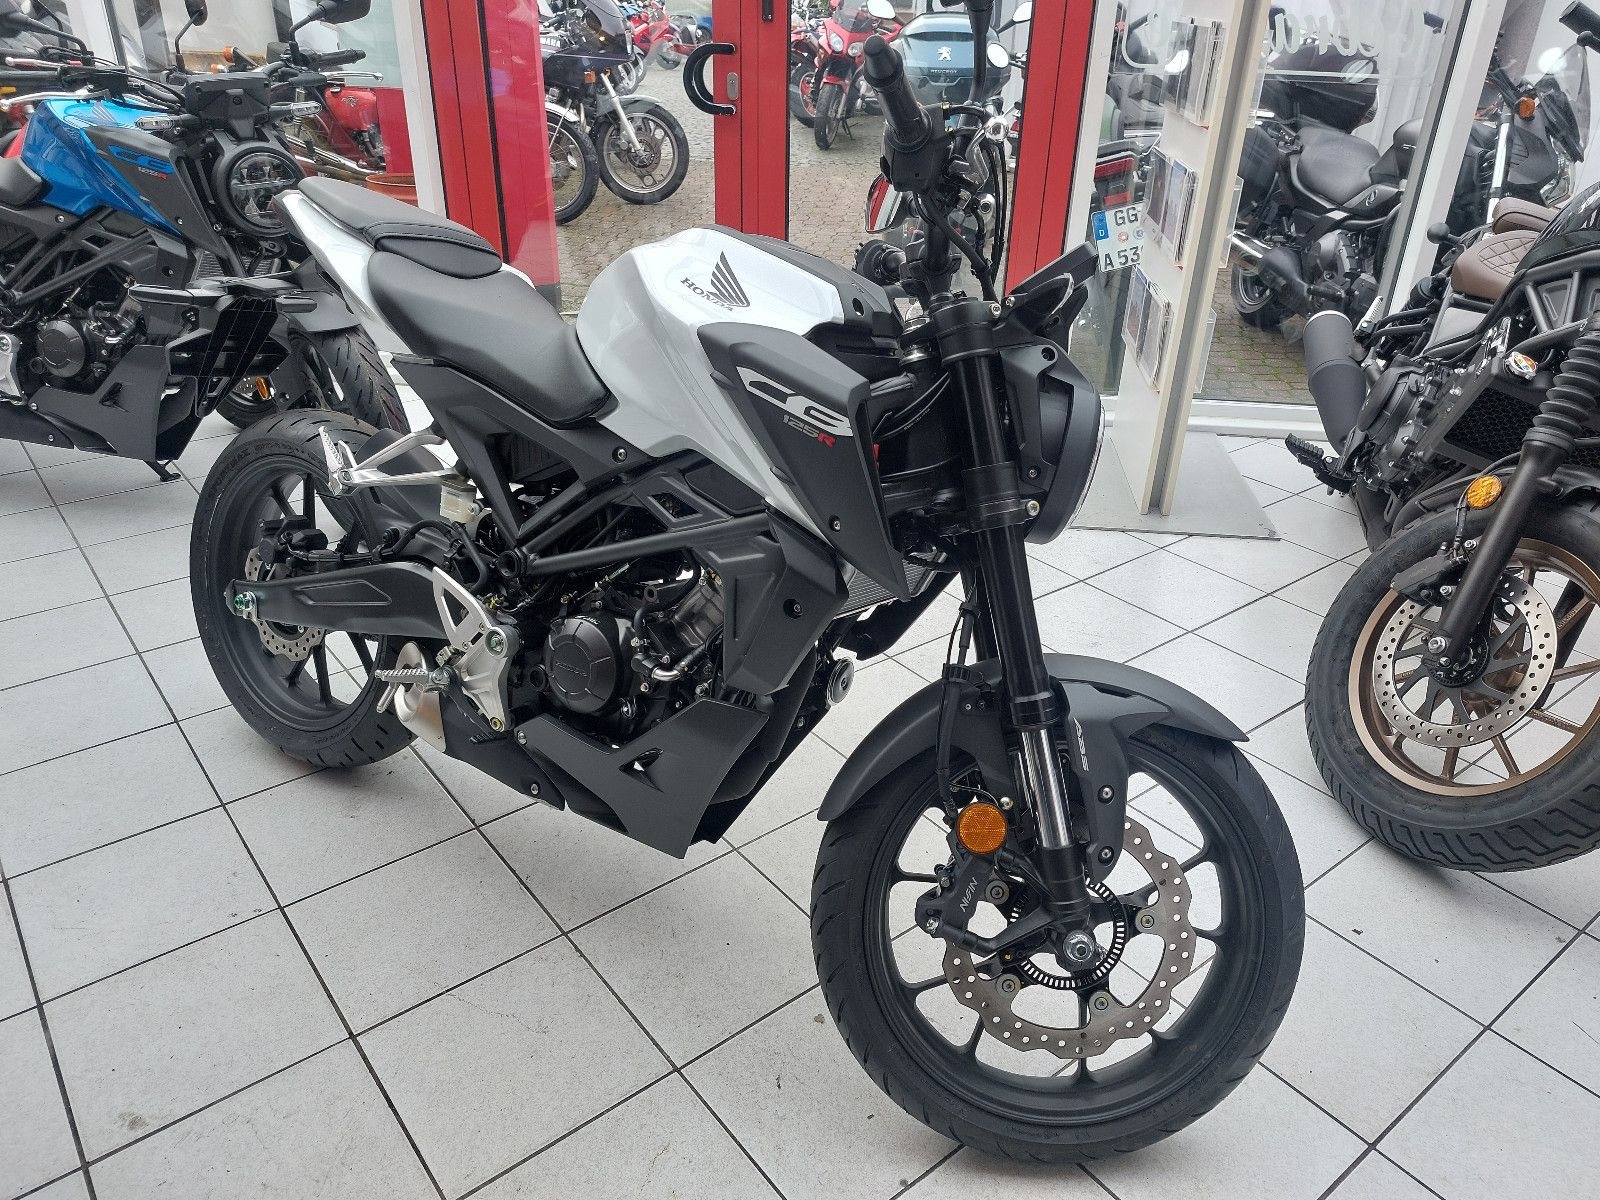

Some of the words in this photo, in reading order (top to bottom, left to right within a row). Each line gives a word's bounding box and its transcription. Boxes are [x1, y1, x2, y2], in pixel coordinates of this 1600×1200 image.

[1114, 206, 1139, 226] GG
[1117, 245, 1144, 266] 53
[680, 277, 734, 312] HONDA
[783, 414, 837, 448] 125R
